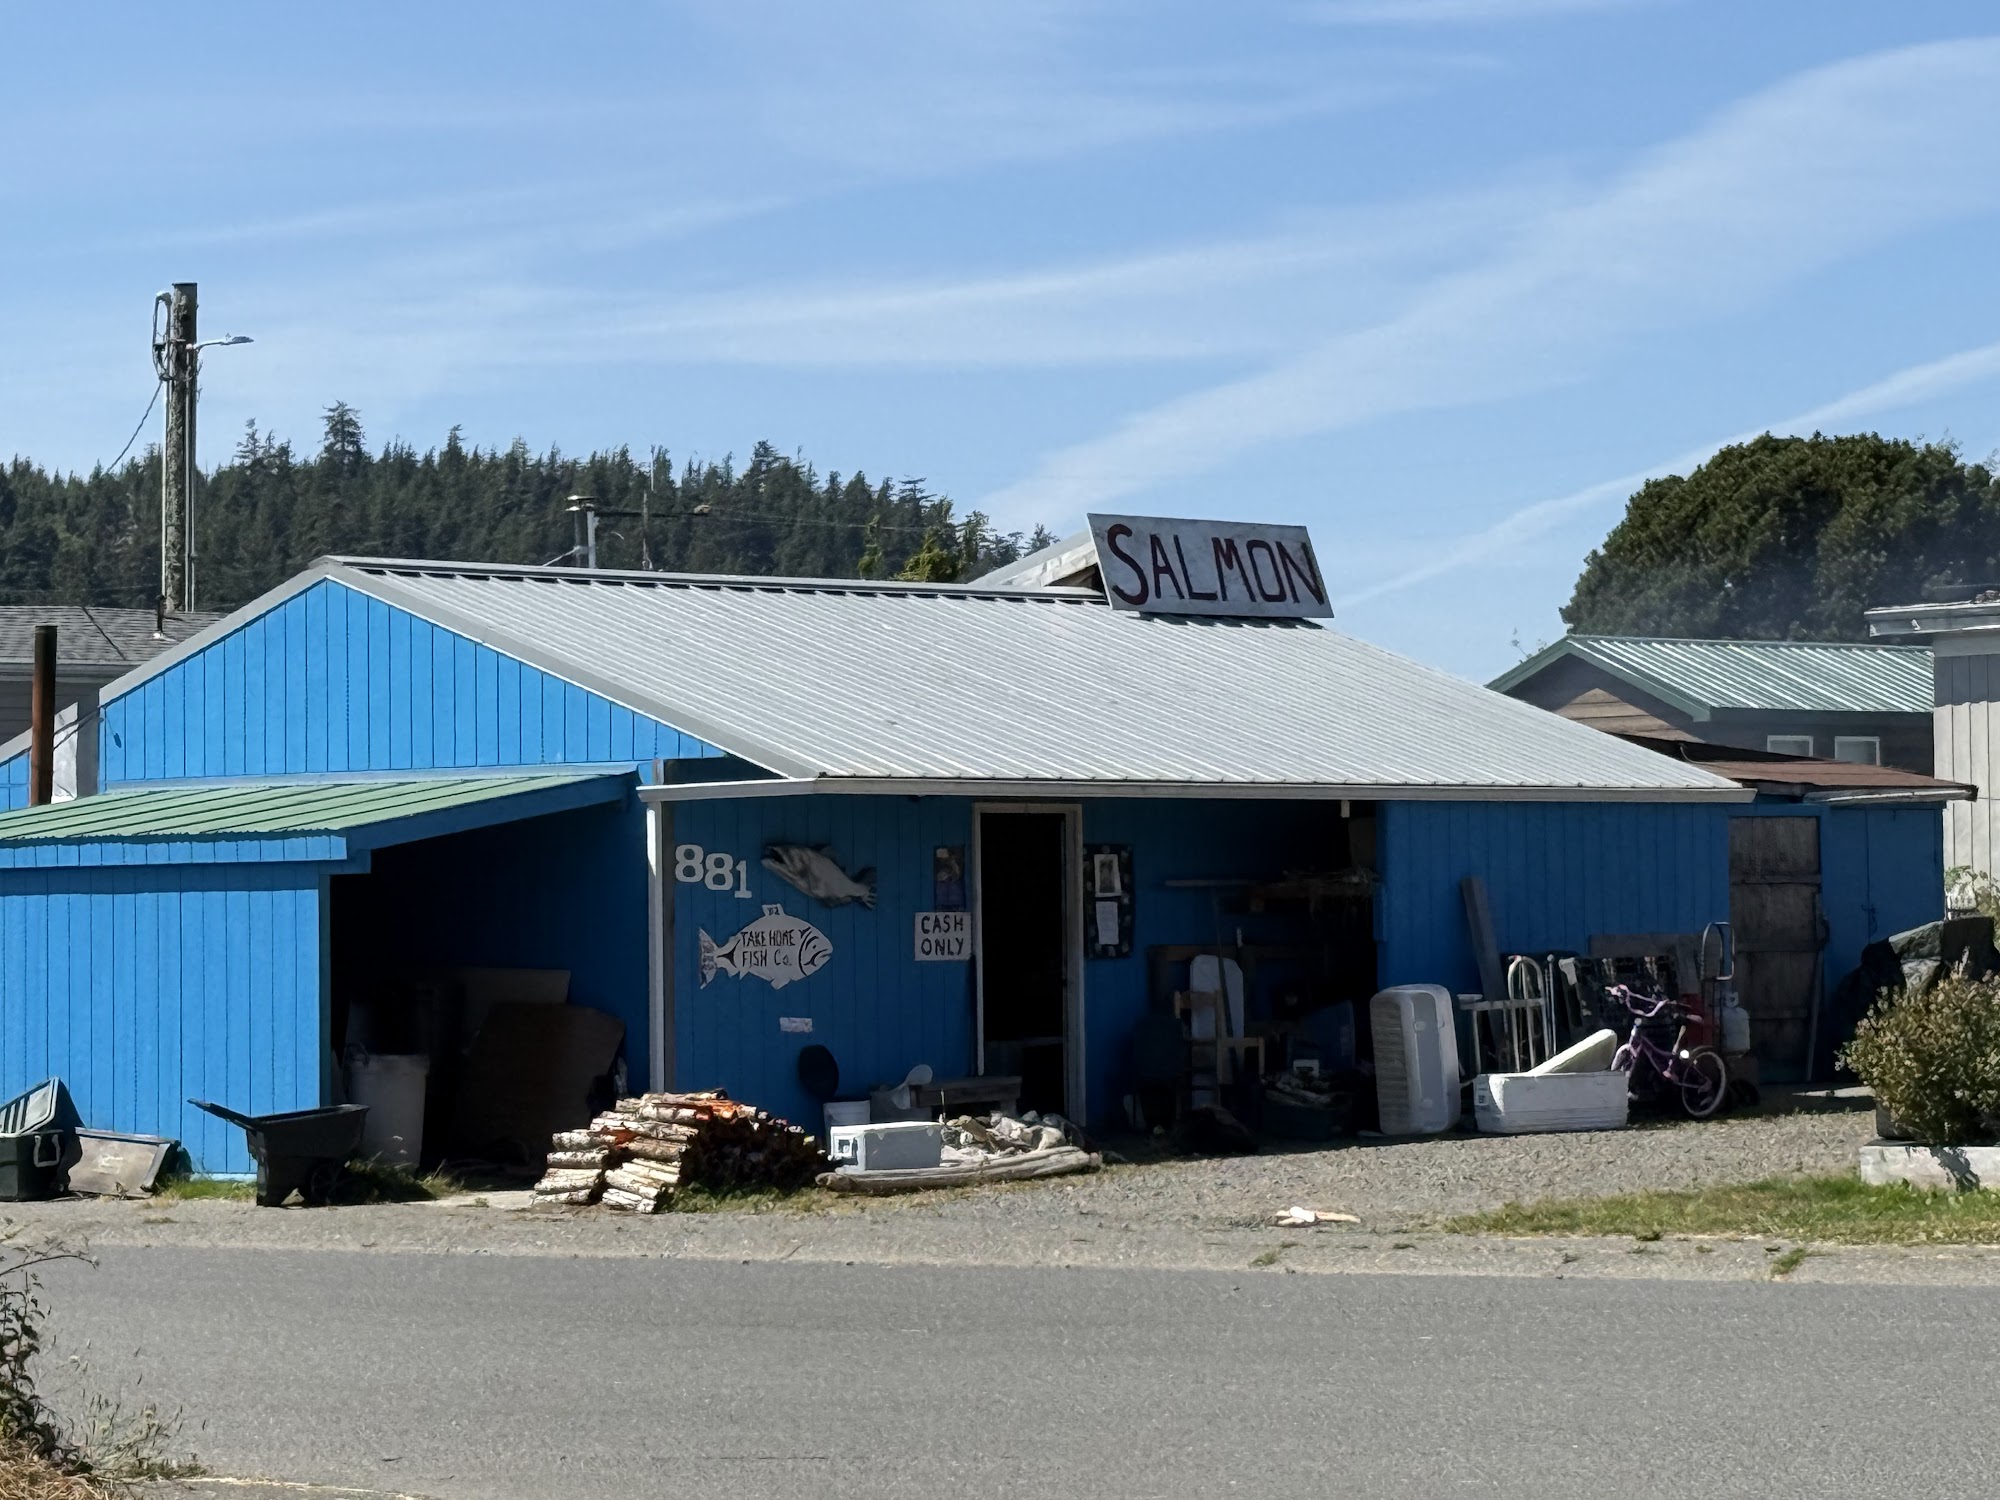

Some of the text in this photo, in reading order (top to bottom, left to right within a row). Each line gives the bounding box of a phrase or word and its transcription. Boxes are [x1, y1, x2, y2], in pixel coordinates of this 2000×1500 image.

[1107, 523, 1326, 606] SALMON
[675, 844, 752, 899] 881
[921, 915, 964, 934] CASH
[740, 929, 795, 947] TAKE HOME
[921, 938, 964, 956] ONLY
[742, 949, 767, 967] FISH
